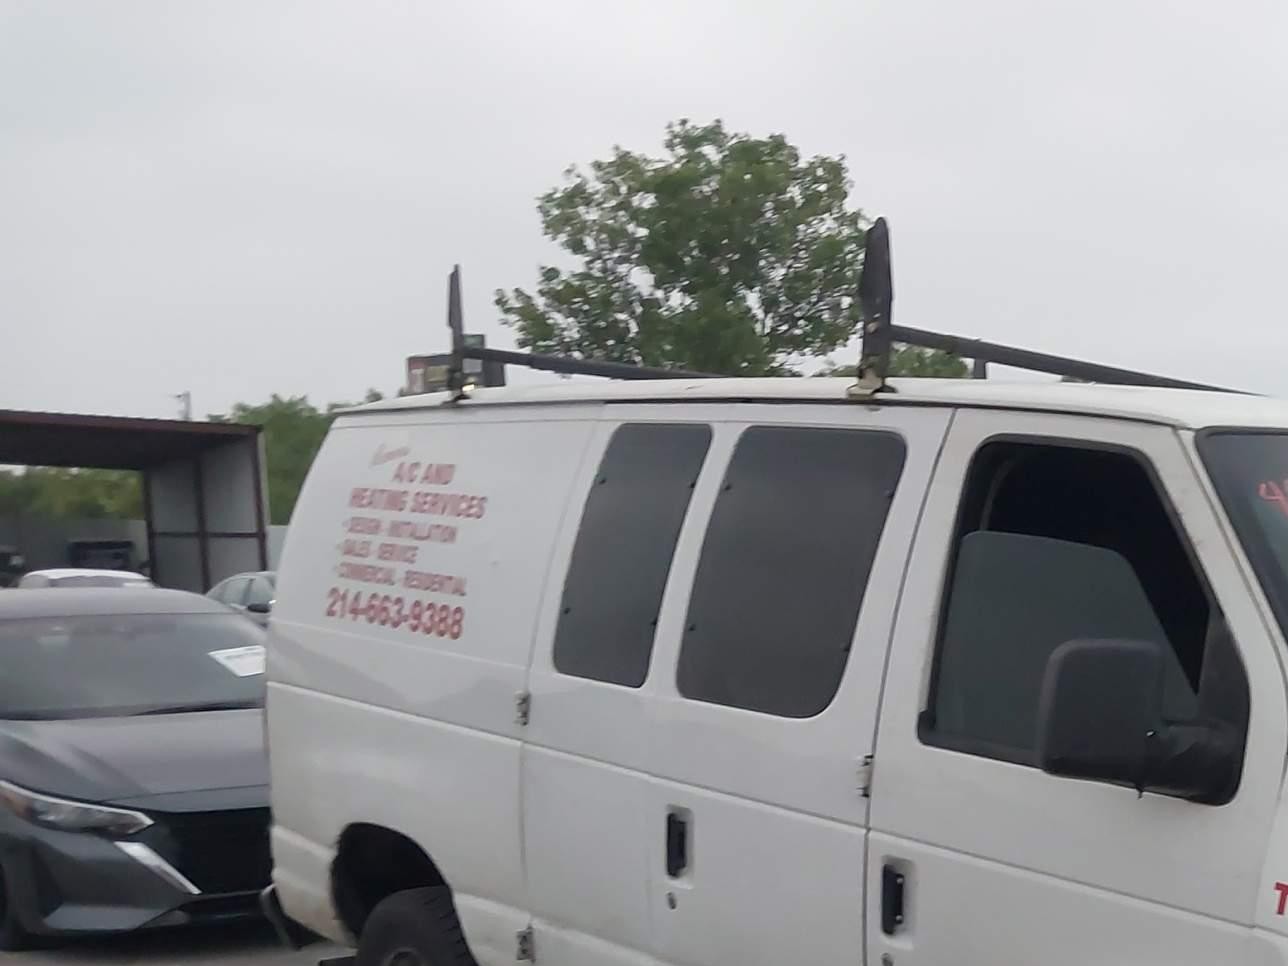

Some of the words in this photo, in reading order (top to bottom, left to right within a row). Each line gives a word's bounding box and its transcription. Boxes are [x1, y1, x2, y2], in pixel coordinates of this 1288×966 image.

[420, 463, 455, 485] AND
[350, 487, 408, 512] HEATING
[410, 491, 488, 519] SERVICES
[326, 587, 464, 640] 214-663-9388
